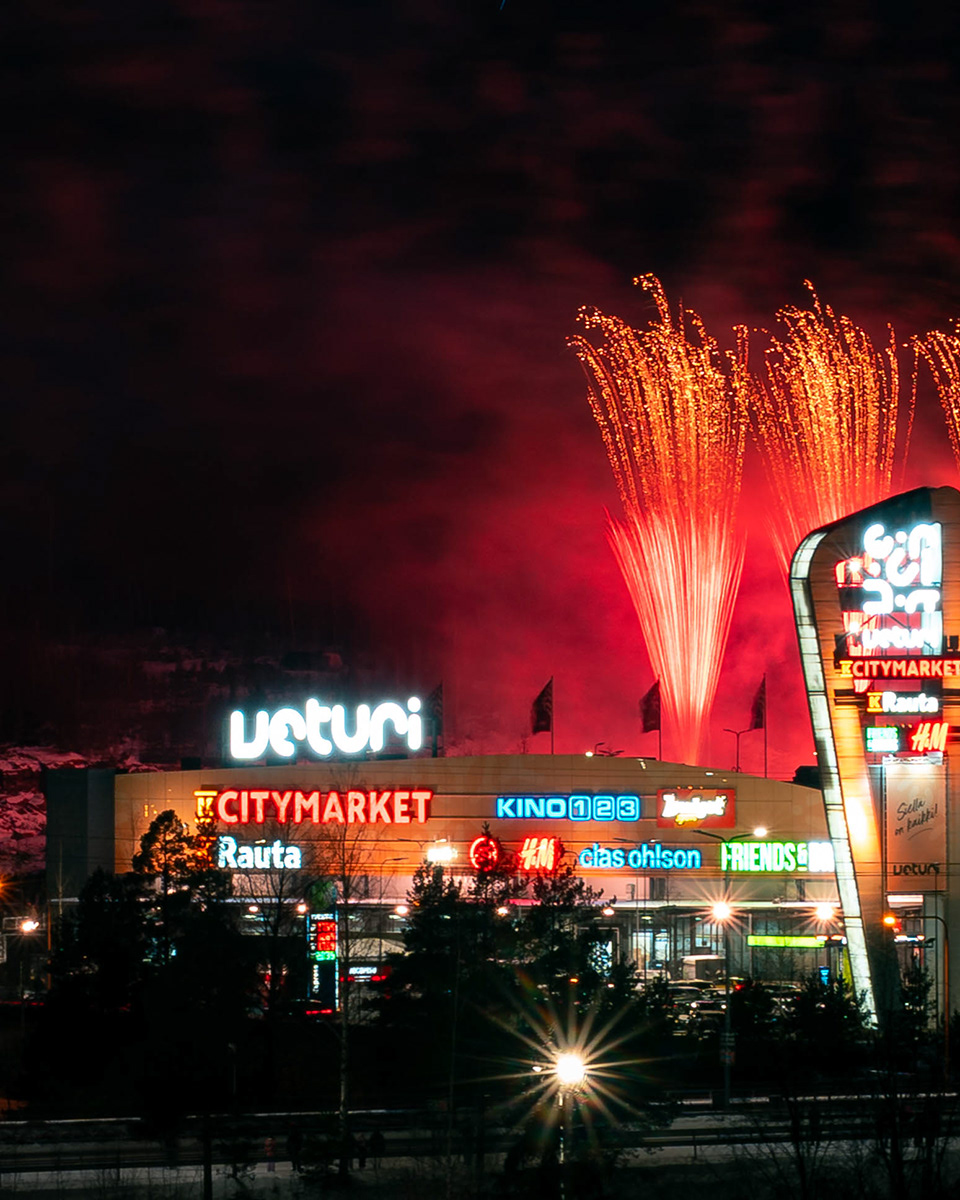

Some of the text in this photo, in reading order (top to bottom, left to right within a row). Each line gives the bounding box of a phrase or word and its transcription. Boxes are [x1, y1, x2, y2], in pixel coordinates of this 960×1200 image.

[230, 696, 422, 759] veturi
[911, 722, 949, 752] H&M
[217, 790, 431, 825] CITYMARKET
[218, 836, 302, 869] Rauta
[518, 837, 556, 871] H&M
[578, 843, 701, 869] clas ohlson
[721, 841, 796, 872] FRIENDS
